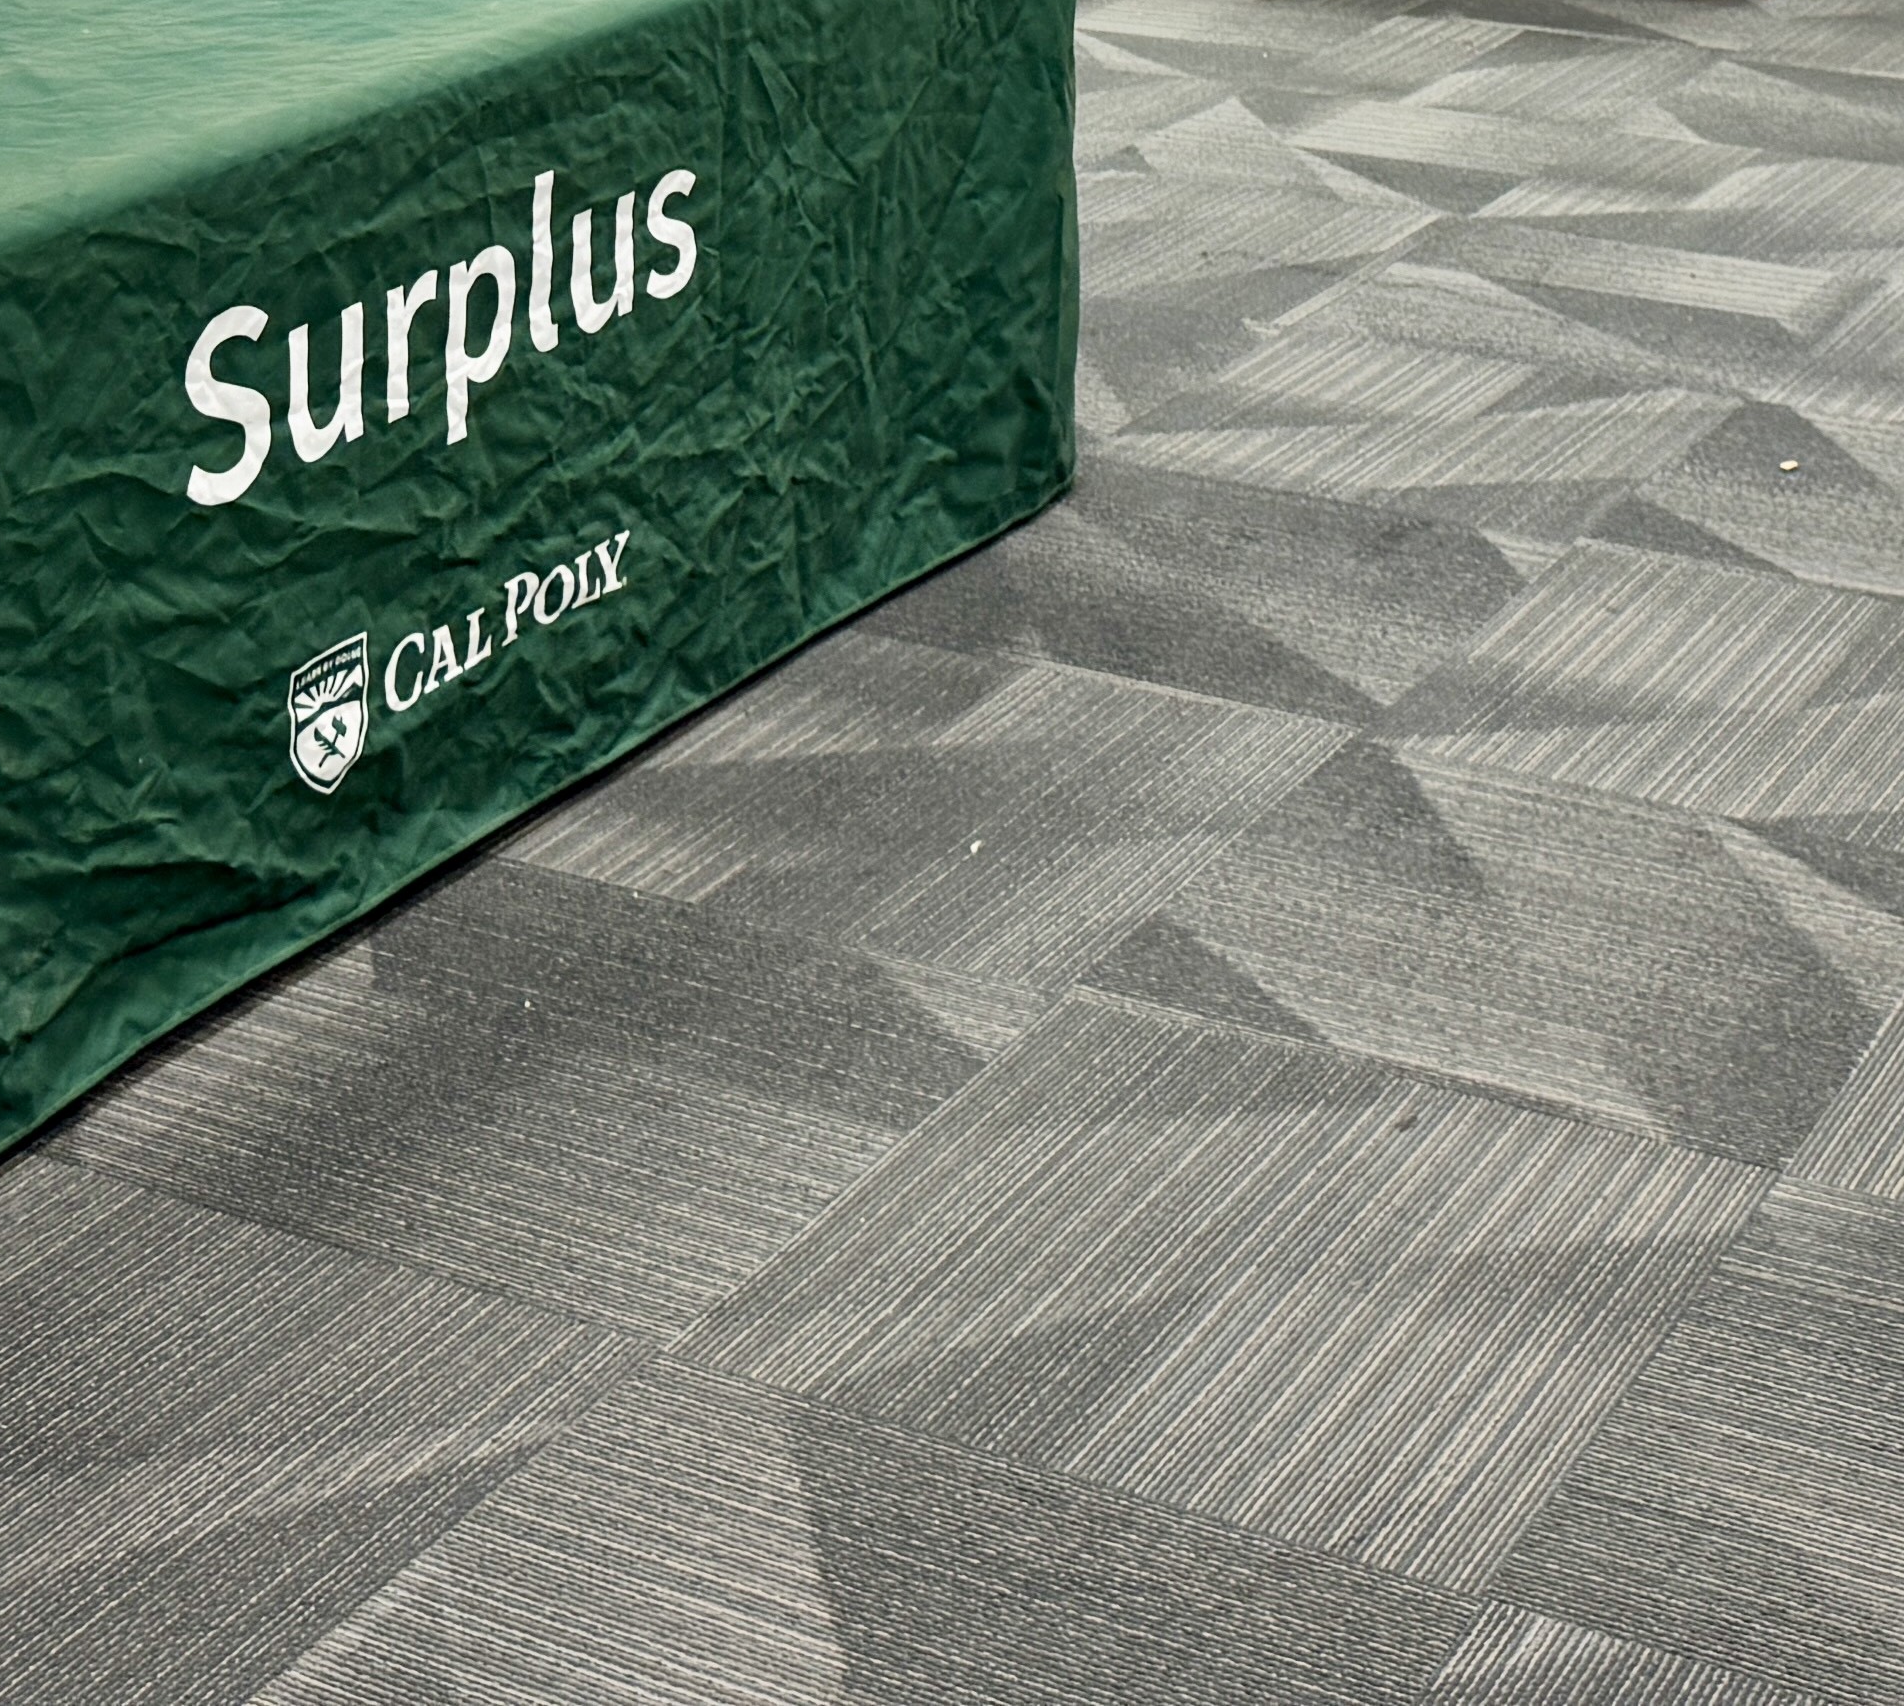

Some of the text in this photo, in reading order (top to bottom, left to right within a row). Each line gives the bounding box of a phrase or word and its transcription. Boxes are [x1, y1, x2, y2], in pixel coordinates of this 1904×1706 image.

[184, 169, 698, 507] Surplus
[384, 529, 631, 712] CAL POLY
